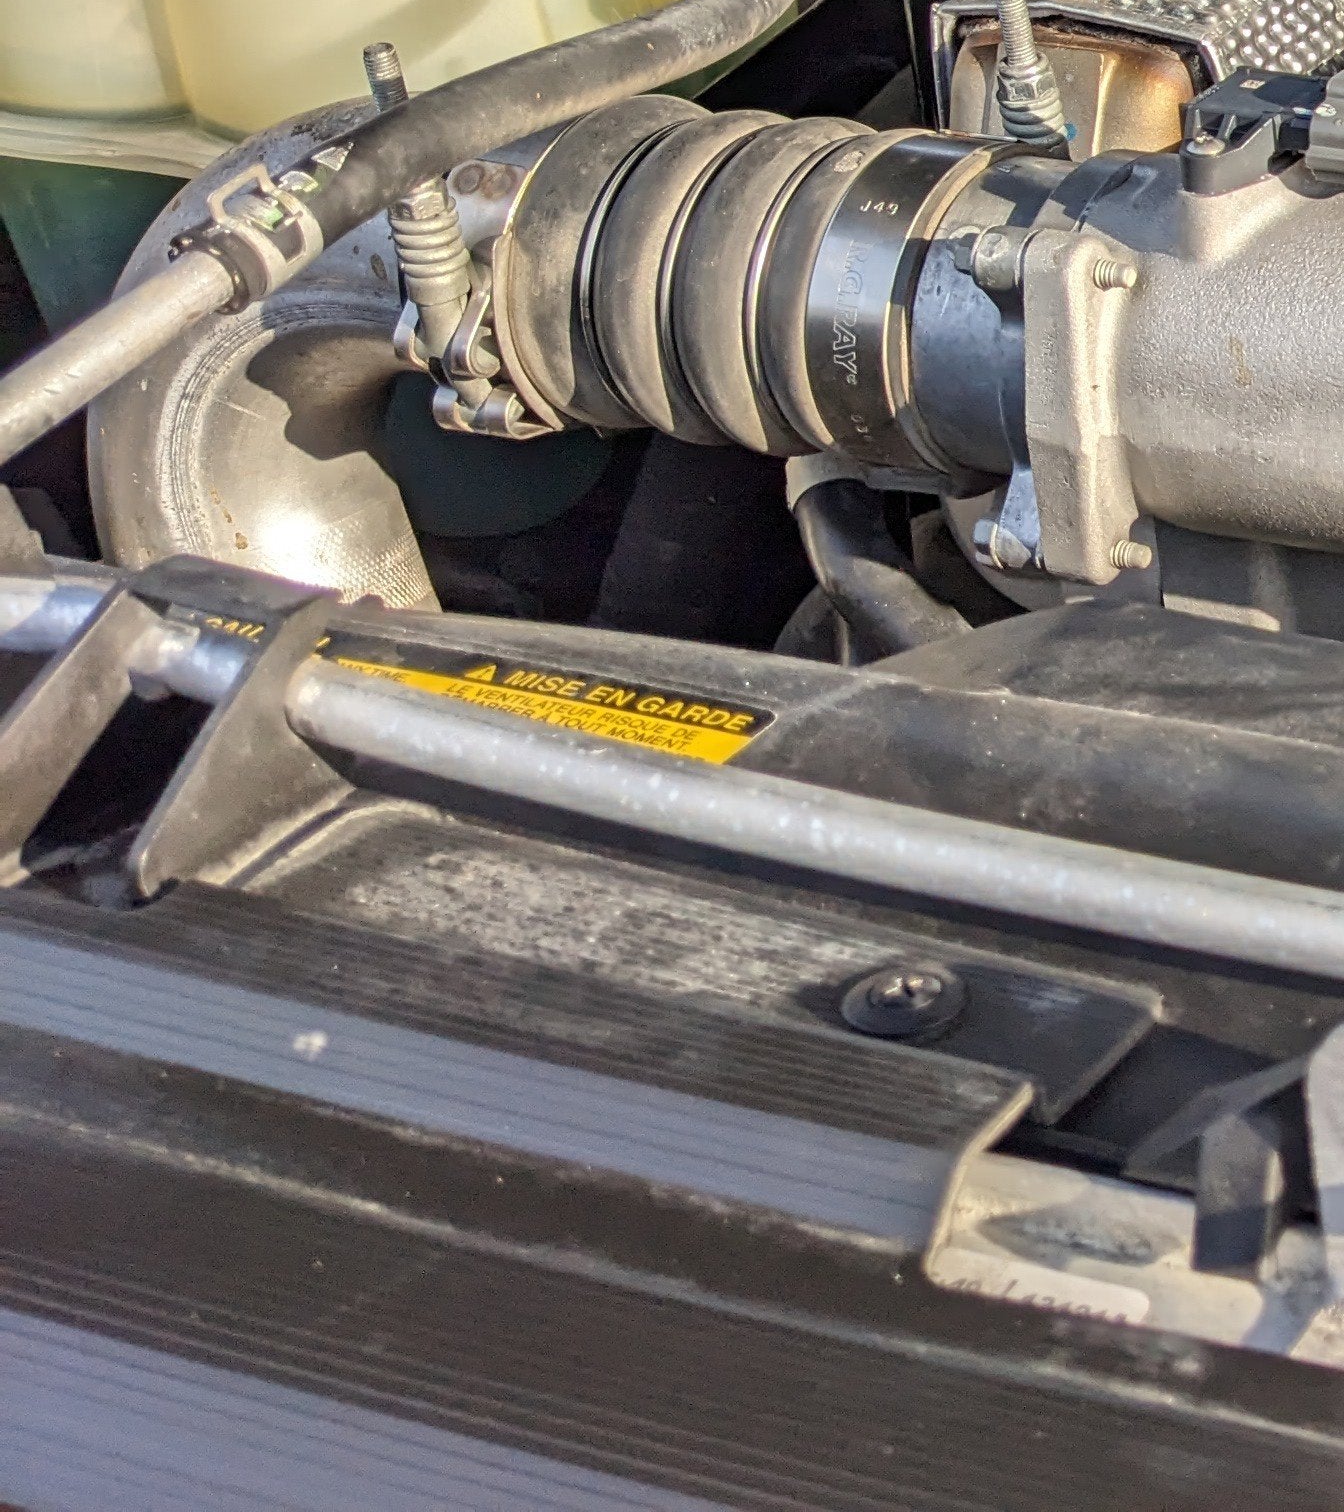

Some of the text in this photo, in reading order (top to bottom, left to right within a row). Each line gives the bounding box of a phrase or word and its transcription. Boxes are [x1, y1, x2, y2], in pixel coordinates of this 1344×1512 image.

[446, 682, 702, 742] LE VENTILATEUR RISQUE DE
[502, 669, 755, 733] MISE EN GARDE
[556, 716, 607, 735] TOUT
[605, 725, 692, 752] MOMENT
